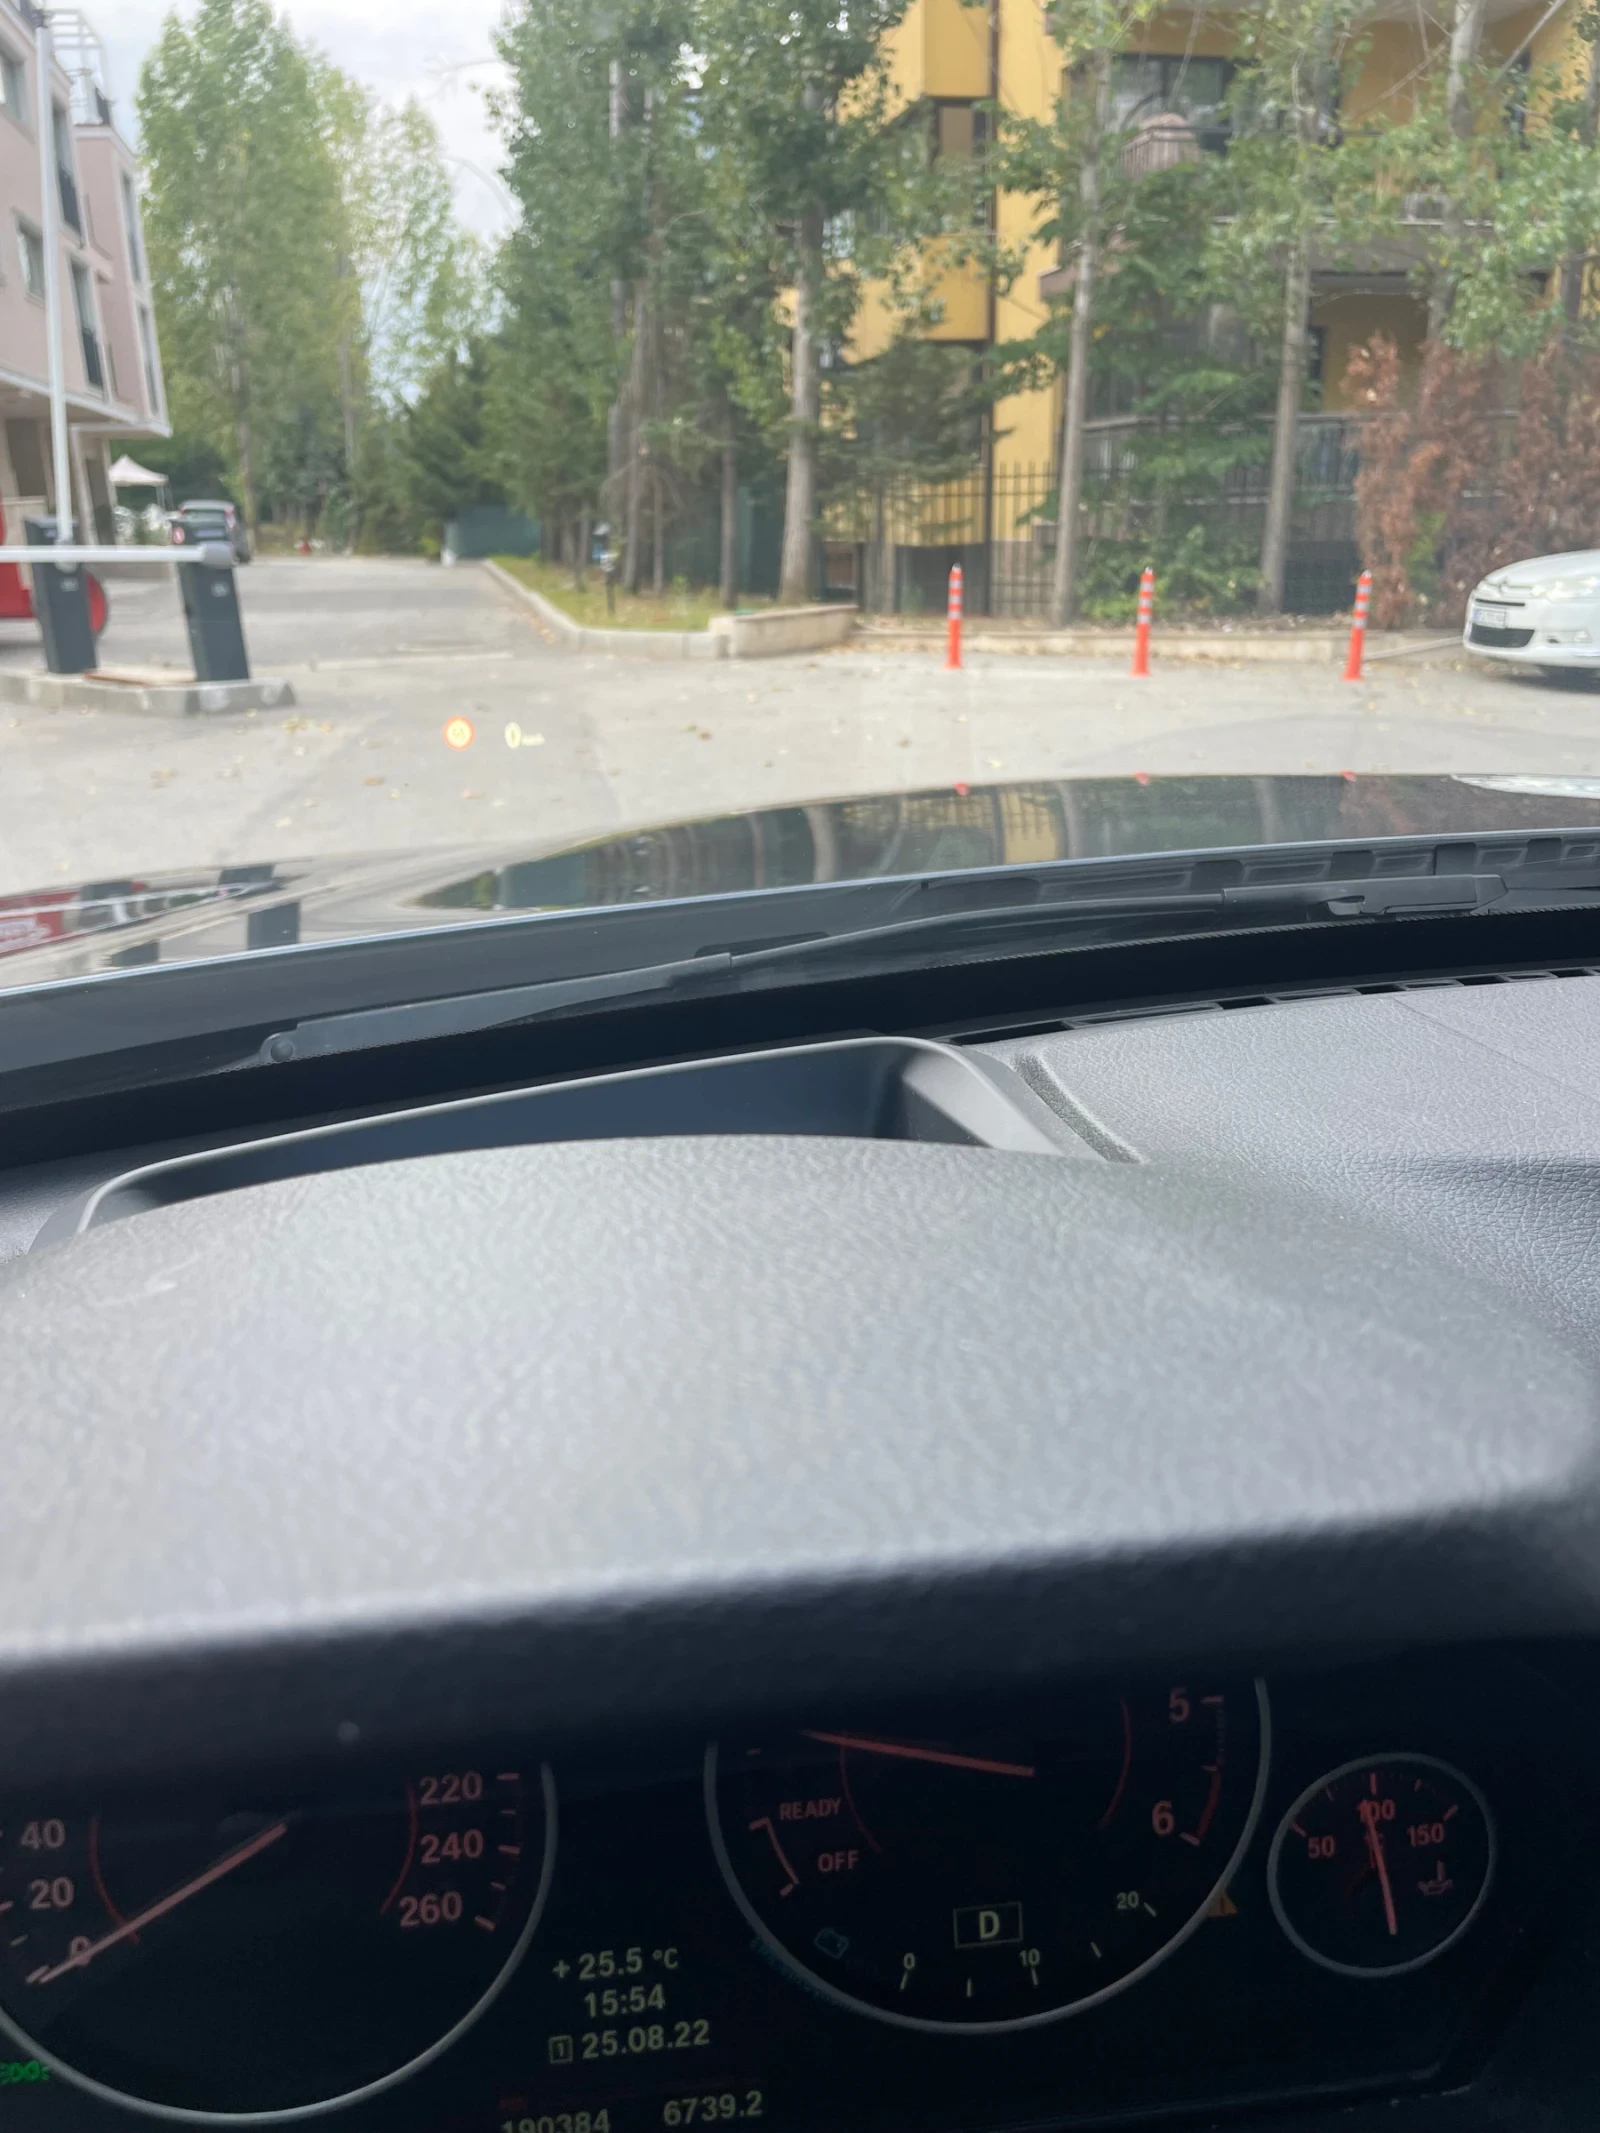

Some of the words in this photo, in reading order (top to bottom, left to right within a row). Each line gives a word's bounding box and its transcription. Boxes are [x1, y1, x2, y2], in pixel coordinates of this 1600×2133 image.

[1168, 1686, 1191, 1722] 5
[419, 1772, 483, 1805] 220
[779, 1797, 842, 1820] READY
[1151, 1801, 1175, 1836] 6
[20, 1818, 66, 1850] 40
[420, 1829, 484, 1864] 240
[1308, 1835, 1336, 1859] 50
[1406, 1822, 1445, 1847] 150
[817, 1850, 859, 1873] OFF
[29, 1876, 75, 1909] 20
[399, 1890, 464, 1928] 260
[1116, 1891, 1140, 1911] 20
[978, 1910, 1001, 1940] D
[578, 1947, 643, 1981] 25.5
[903, 1952, 916, 1970] 0
[1019, 1948, 1041, 1967] 10
[584, 1983, 666, 2019] 15:54
[581, 2018, 712, 2060] 25.08.22
[662, 2090, 763, 2127] 6739.2
